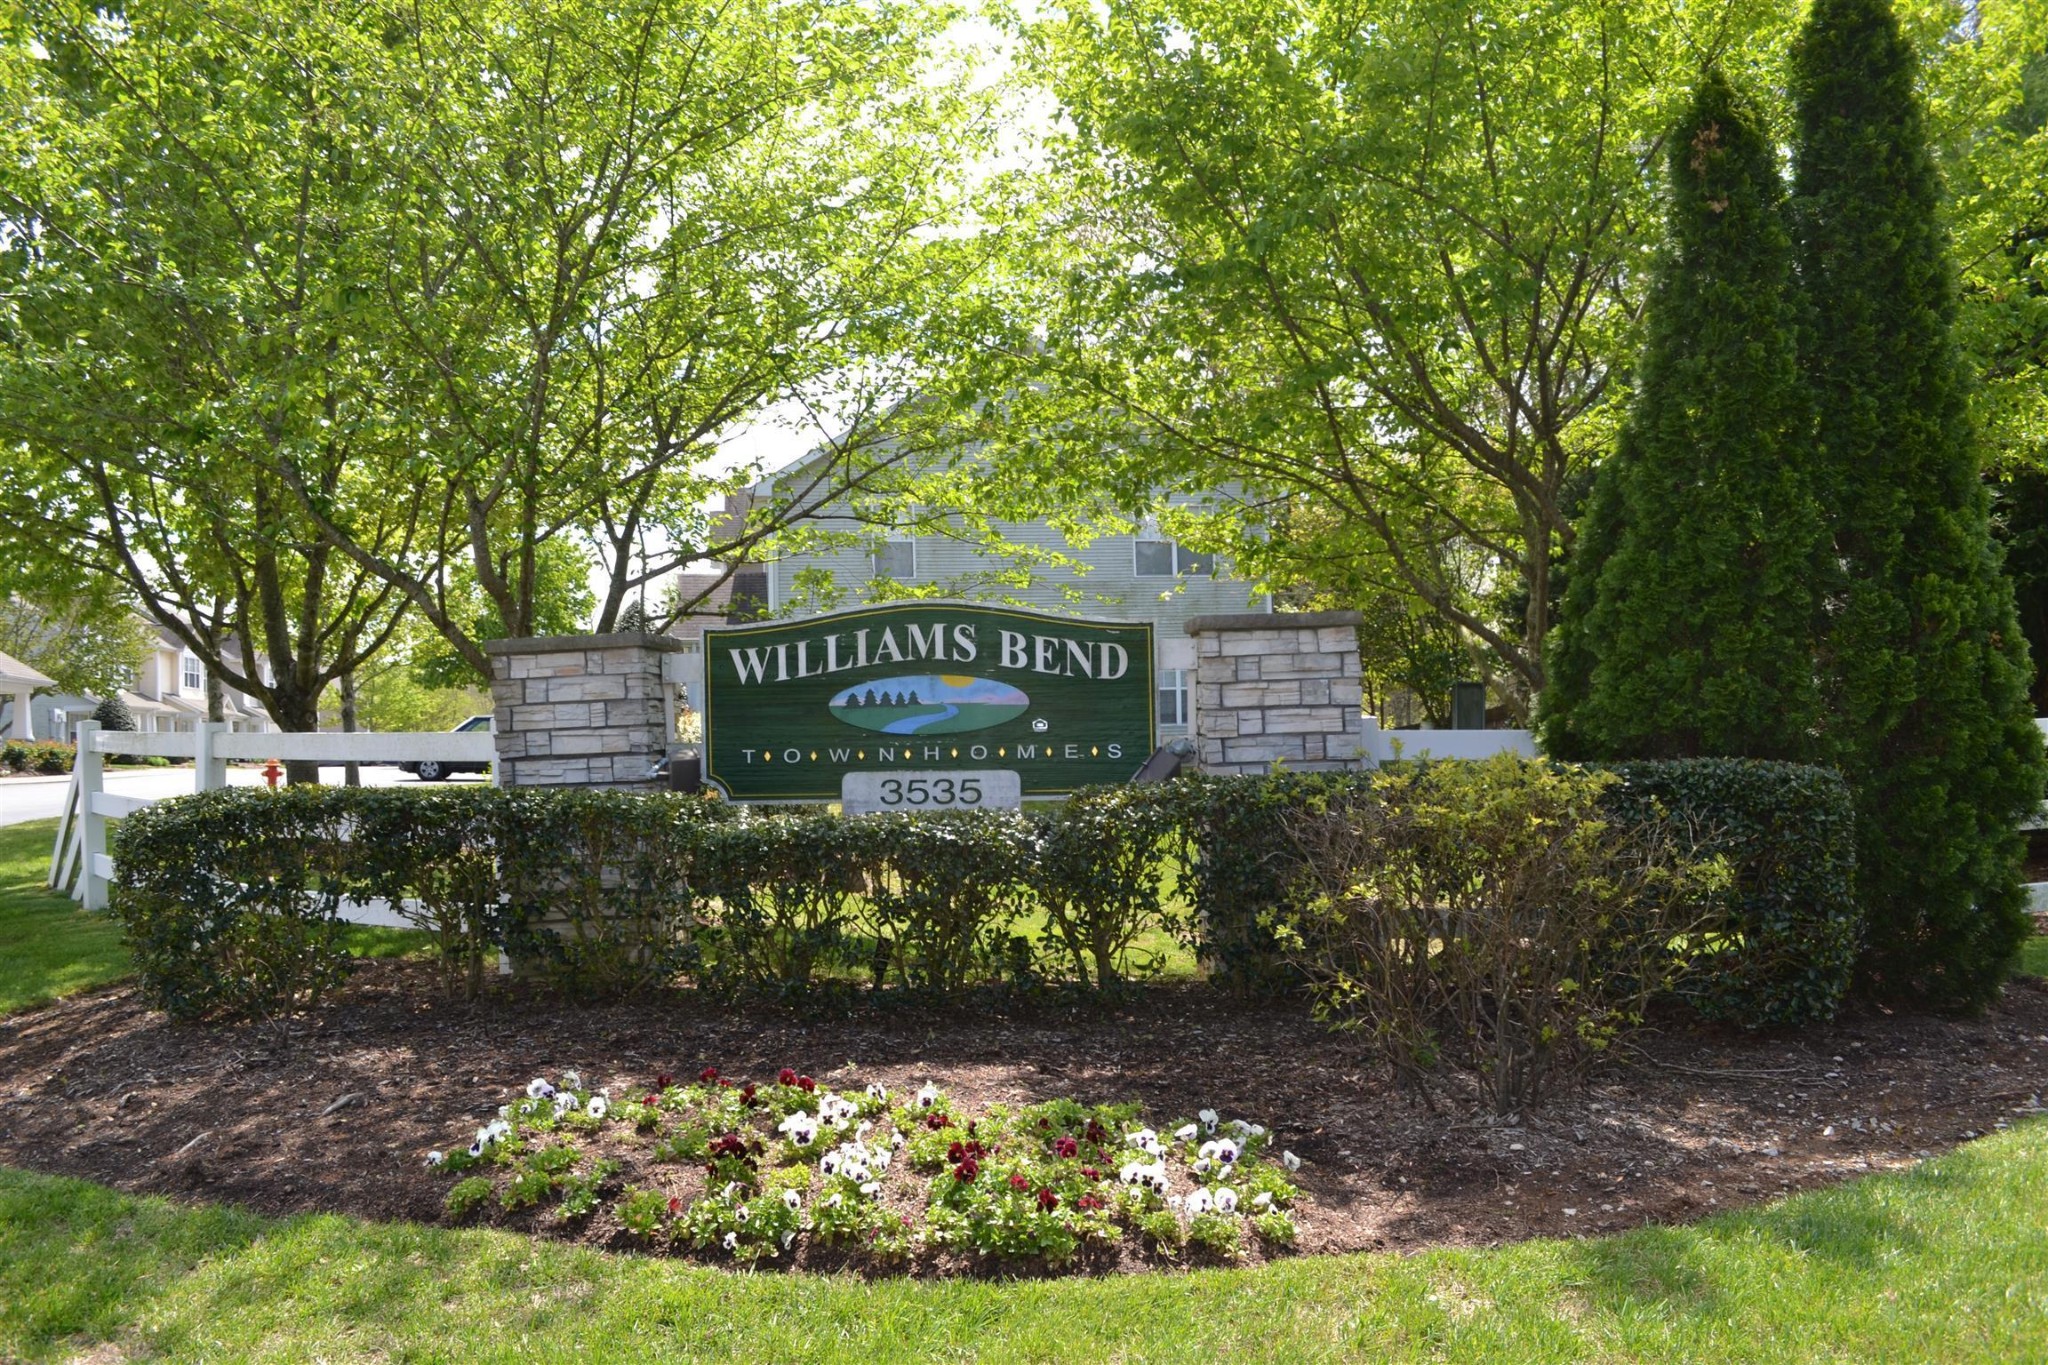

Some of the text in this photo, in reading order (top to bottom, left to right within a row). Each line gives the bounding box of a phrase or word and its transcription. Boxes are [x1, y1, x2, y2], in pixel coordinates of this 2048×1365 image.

[729, 623, 1128, 685] WILLIAMS BEND
[880, 778, 982, 805] 3535
